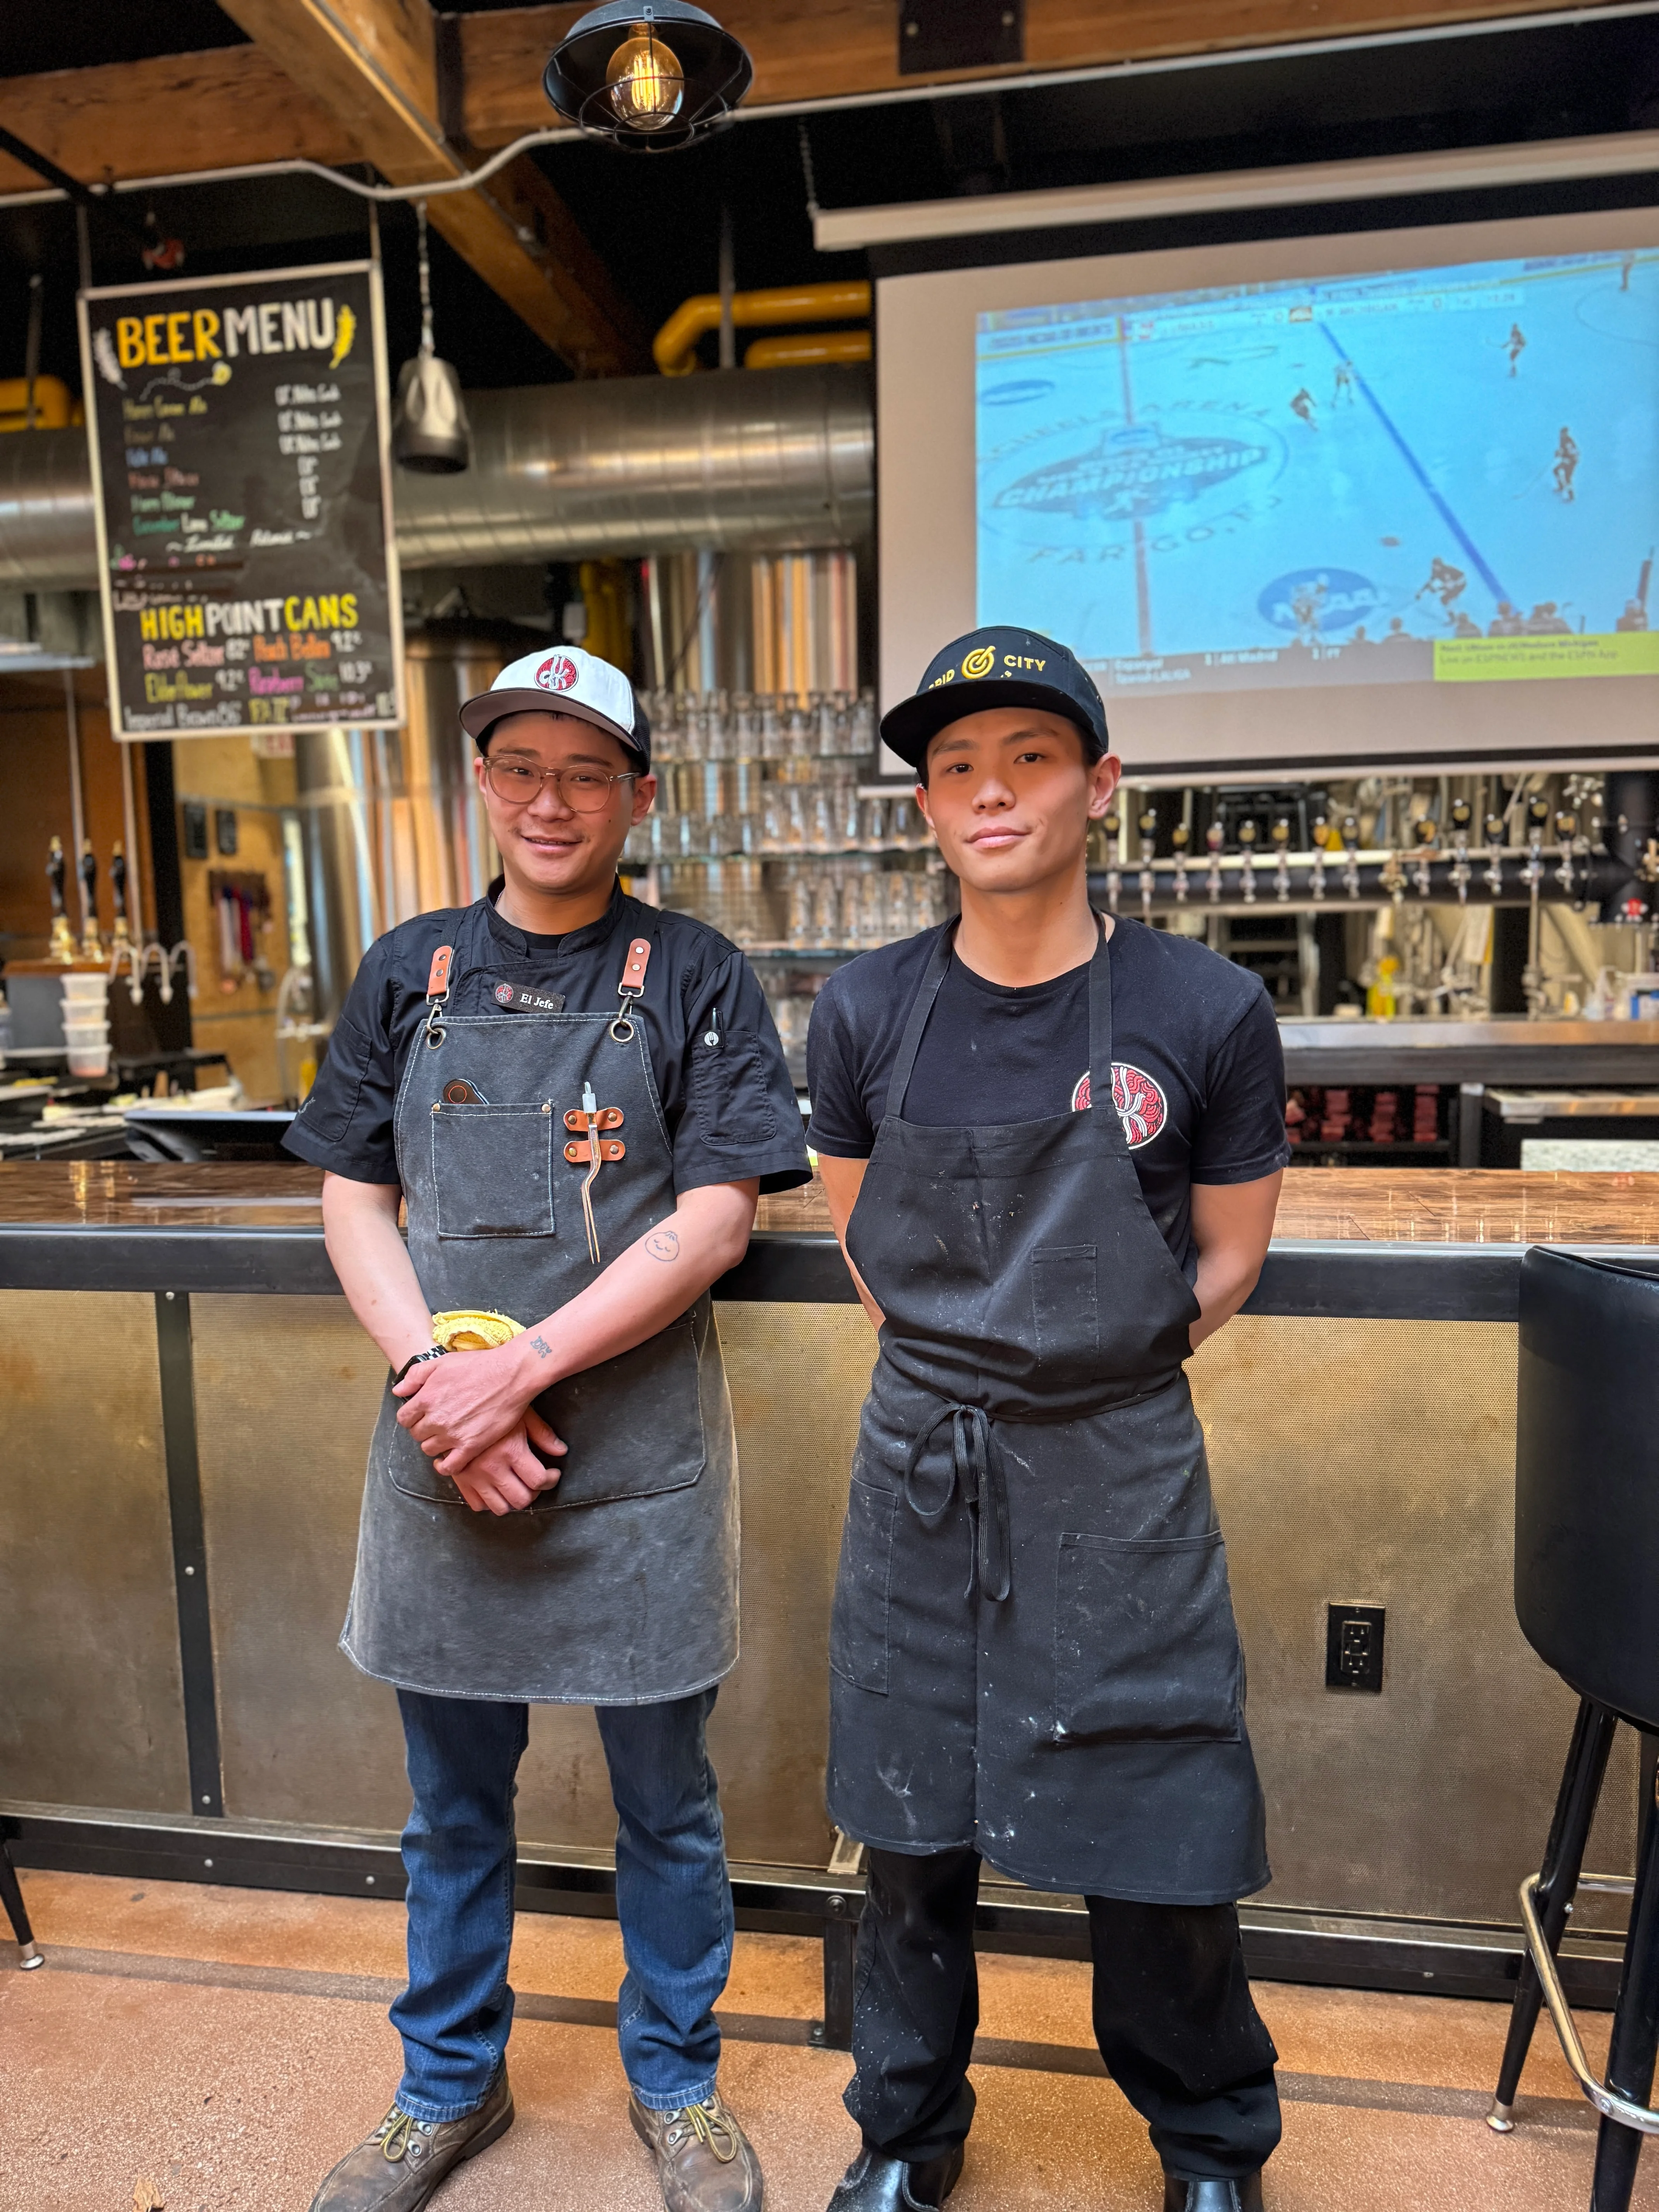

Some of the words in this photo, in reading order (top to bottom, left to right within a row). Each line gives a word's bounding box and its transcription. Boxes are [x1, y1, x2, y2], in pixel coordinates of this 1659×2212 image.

[117, 309, 222, 368] BEER
[223, 298, 336, 357] MENU
[998, 447, 1264, 507] CHAMPIONSHIP
[140, 604, 205, 641] HIGH
[205, 598, 284, 638] POINT
[284, 593, 359, 632] CANS
[1003, 654, 1046, 672] CITY
[520, 993, 532, 1004] El
[534, 997, 554, 1010] Jefe
